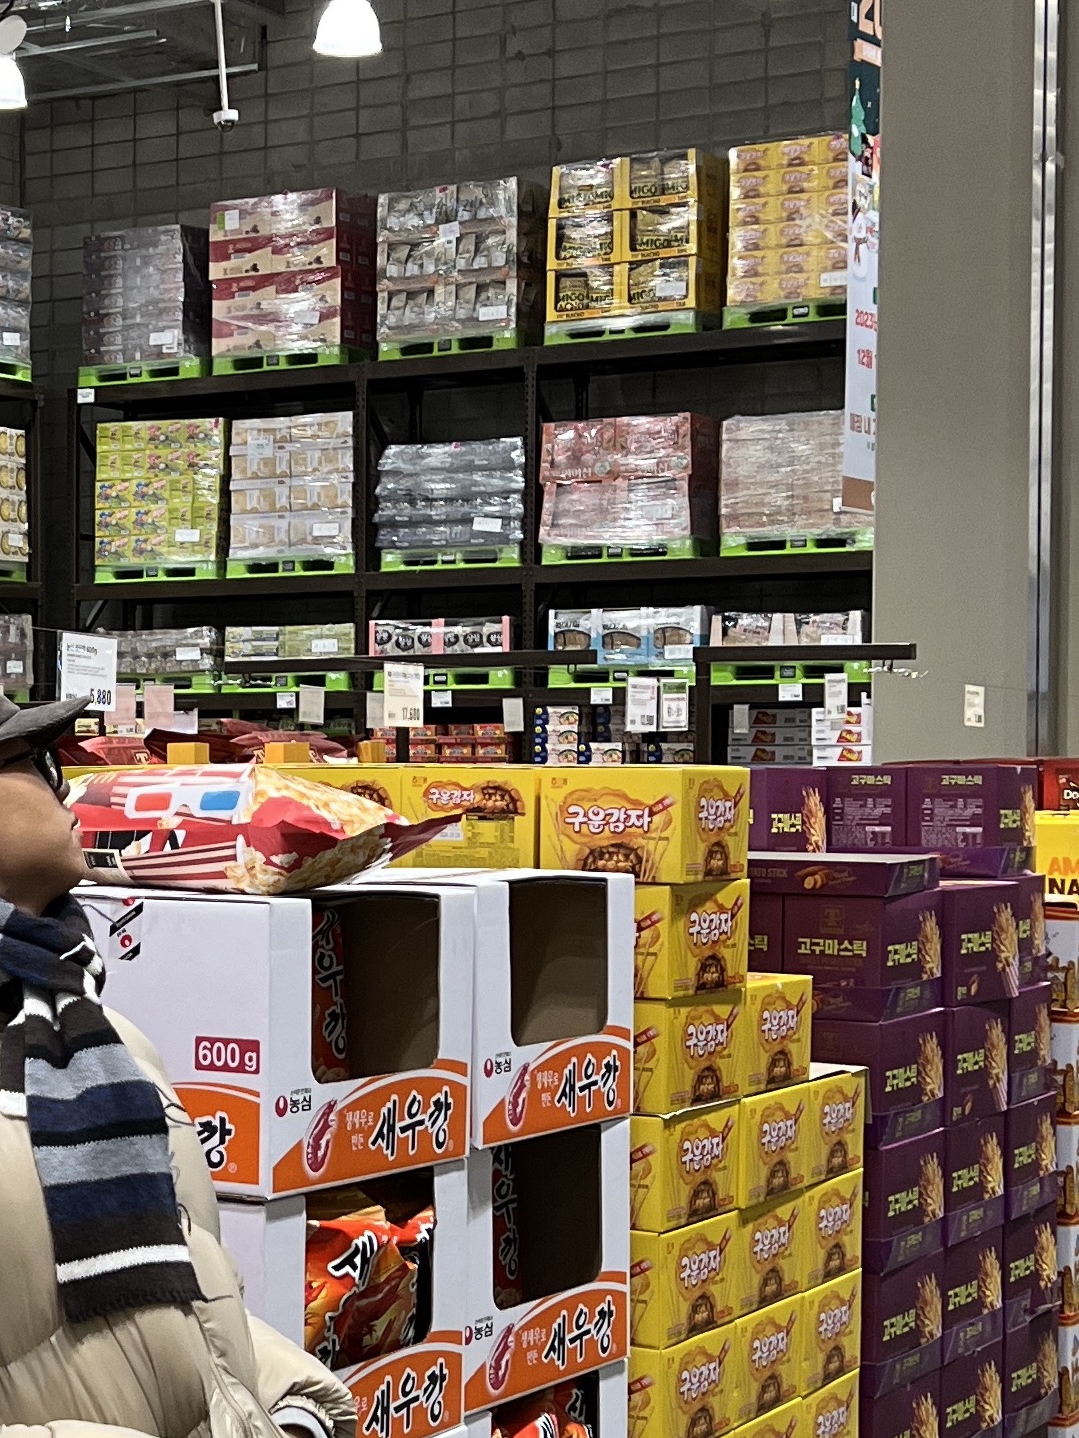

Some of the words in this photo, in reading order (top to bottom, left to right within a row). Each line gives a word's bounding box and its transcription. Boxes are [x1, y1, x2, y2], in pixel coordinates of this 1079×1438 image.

[427, 787, 475, 805] 구운감자
[851, 775, 892, 785] 고구마스틱
[941, 775, 983, 785] 고구마스틱
[565, 804, 652, 833] 구운감자
[698, 796, 735, 831] 구운감자
[771, 812, 802, 834] 고구마스틱
[689, 911, 733, 947] 구운감자
[960, 930, 992, 955] 고구마스틱
[797, 937, 867, 958] 고구마스틱
[886, 940, 918, 968] 고구마스틱
[685, 1022, 729, 1058] 구운감자
[759, 1006, 800, 1042] 구운감자
[494, 1058, 512, 1075] 농심
[885, 1064, 918, 1093] 고구마스틱
[956, 1048, 985, 1076] 고구마스틱
[555, 1049, 621, 1117] 새우깡
[289, 1095, 312, 1114] 농심
[821, 1100, 854, 1133] 구운감자
[369, 1086, 453, 1161] 새우깡
[760, 1118, 798, 1154] 구운감자
[681, 1135, 725, 1174] 구운감자
[887, 1185, 919, 1218] 고구마스틱
[818, 1203, 851, 1238] 구운감자
[752, 1221, 791, 1262] 구운감자
[679, 1247, 722, 1290] 구운감자
[473, 1321, 494, 1341] 농심
[542, 1294, 616, 1371] 새우깡
[817, 1303, 850, 1340] 구운감자
[882, 1308, 916, 1343] 고구마스틱
[751, 1331, 790, 1372] 구운감자
[679, 1357, 722, 1401] 구운감자
